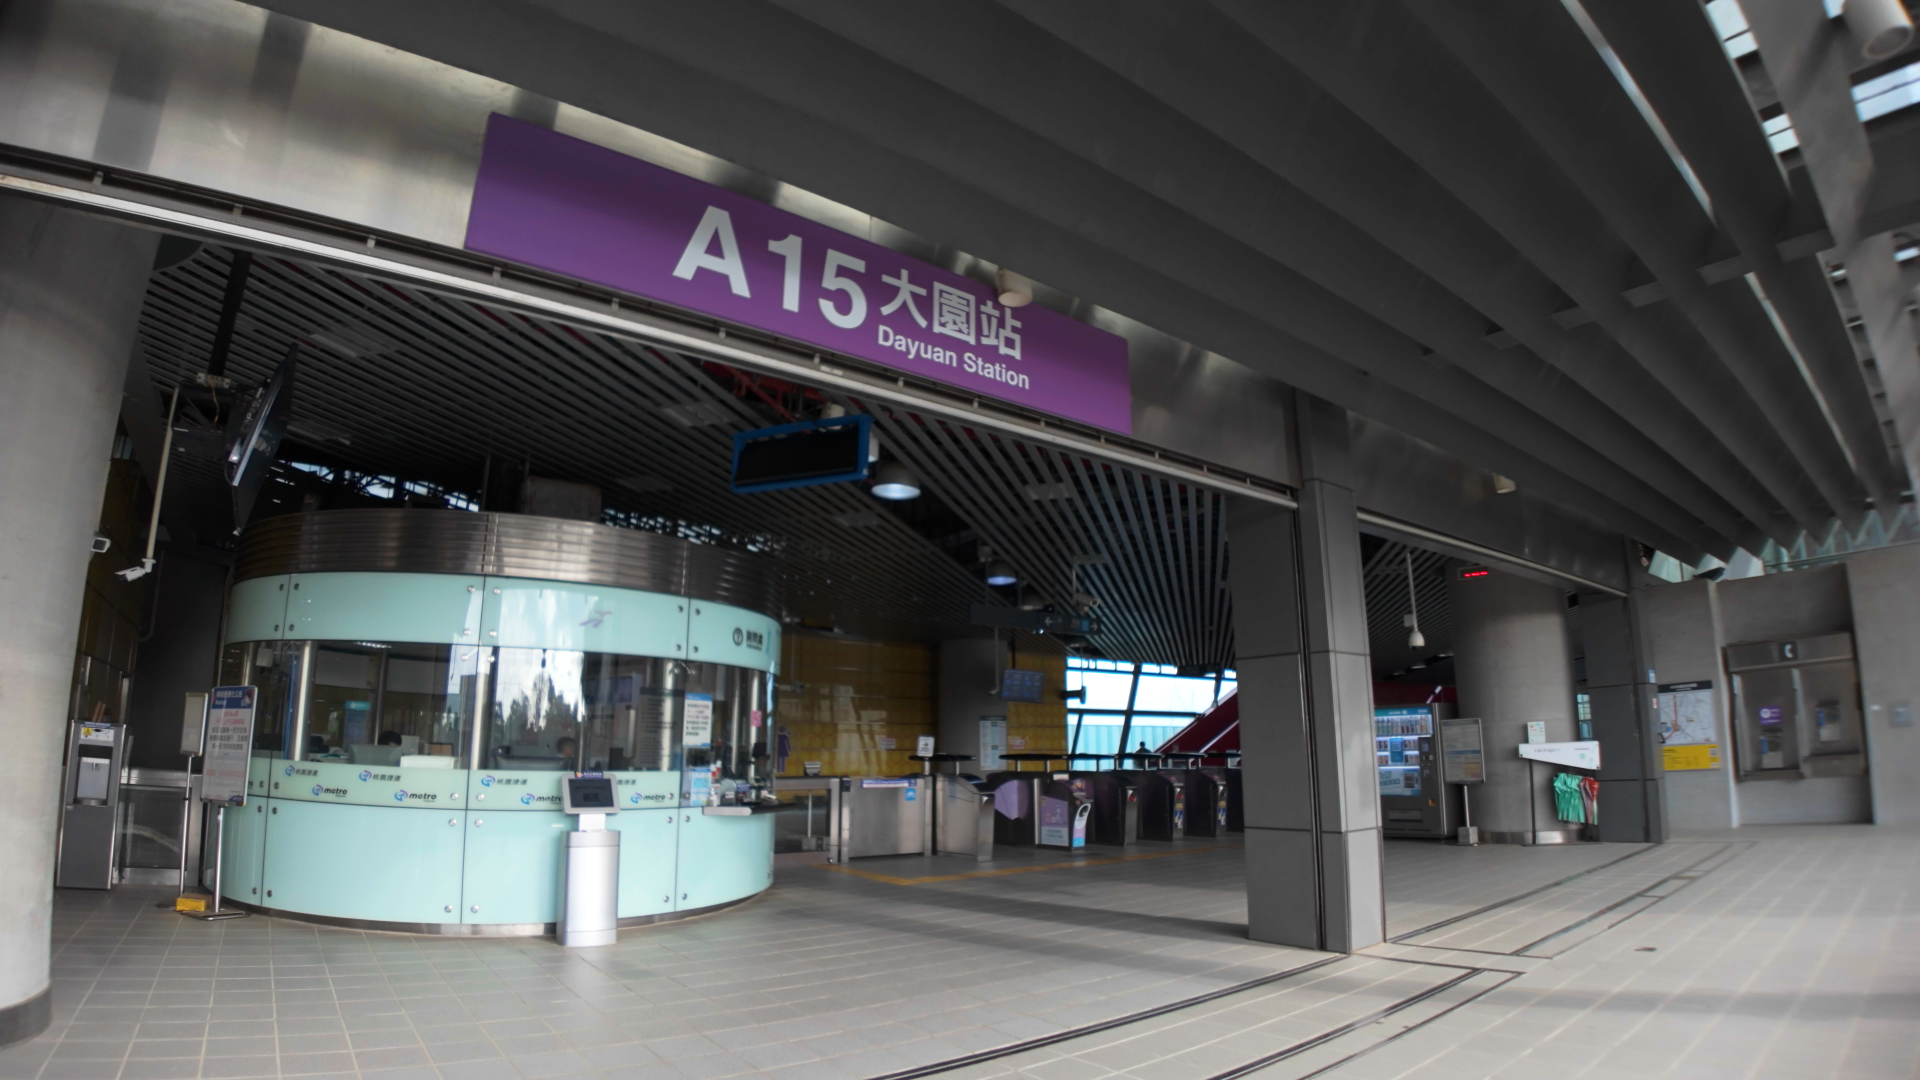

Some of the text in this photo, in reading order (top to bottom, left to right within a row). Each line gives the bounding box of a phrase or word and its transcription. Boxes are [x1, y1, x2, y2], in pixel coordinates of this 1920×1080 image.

[672, 205, 1022, 360] A15 大園站
[878, 325, 1029, 389] Dayuan Station
[372, 773, 402, 782] 桃園捷運
[324, 787, 348, 795] metro
[408, 792, 437, 800] metro
[643, 793, 666, 801] metro
